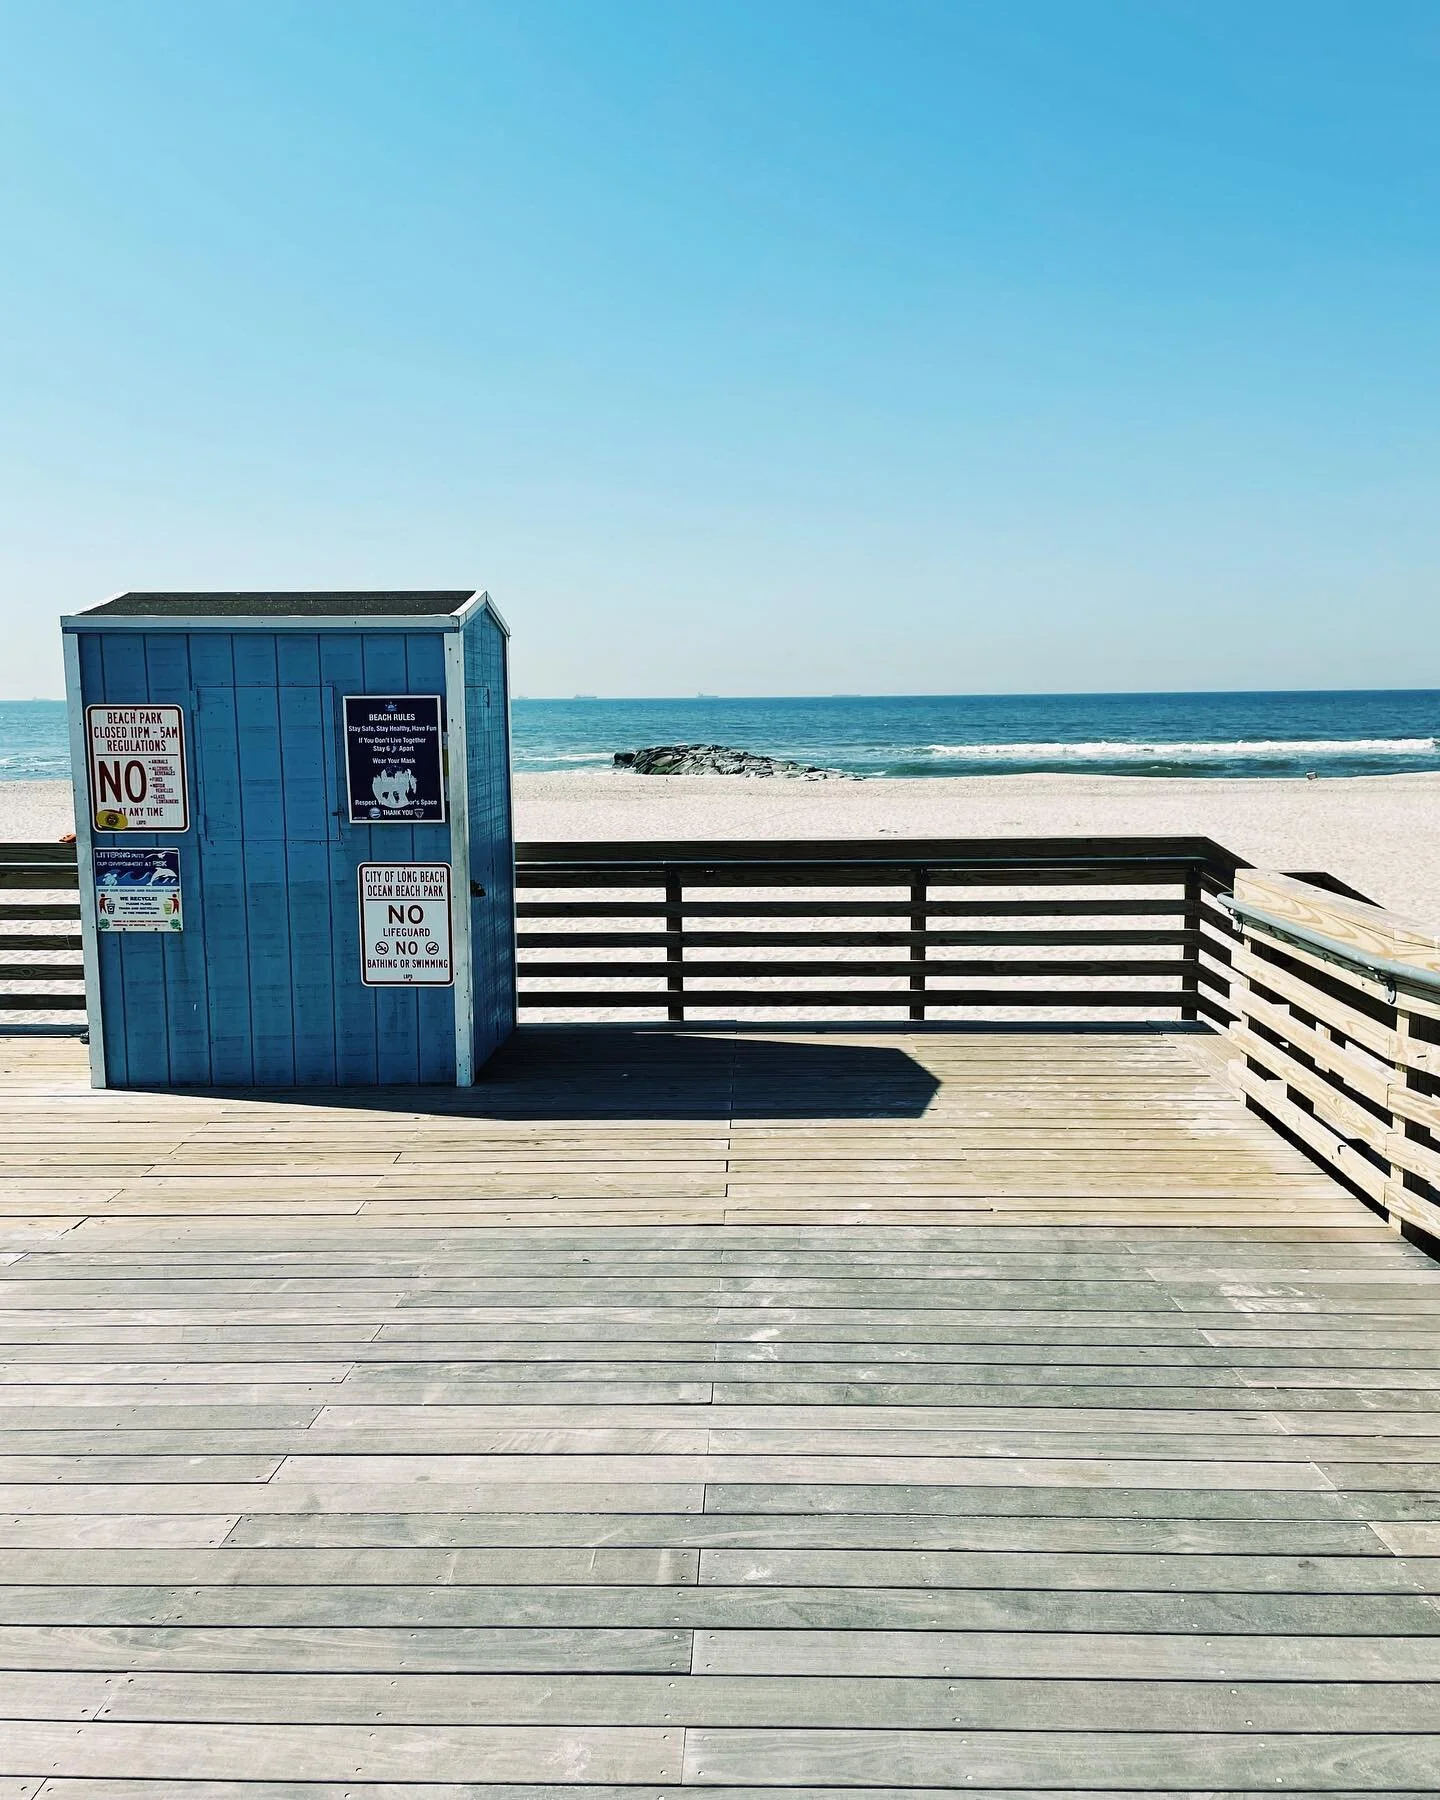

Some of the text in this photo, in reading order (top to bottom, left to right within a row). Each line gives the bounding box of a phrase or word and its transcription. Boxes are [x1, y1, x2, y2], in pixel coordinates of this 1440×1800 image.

[107, 712, 163, 724] BEACH PARK
[94, 726, 127, 738] CLOSED
[130, 726, 150, 738] 11PM
[160, 726, 178, 738] 5AM
[389, 725, 412, 733] Healthy,
[107, 740, 166, 751] REGULATIONS
[373, 745, 386, 753] Stay
[398, 745, 415, 753] Apart
[98, 760, 147, 803] NO
[129, 807, 144, 817] ANY
[147, 807, 164, 817] TIME
[365, 871, 445, 883] CITY OF LONG BEACH
[367, 885, 444, 897] OCEAN BEACH PARK
[388, 904, 424, 924] NO
[383, 928, 431, 937] LIFEGUARD
[395, 941, 418, 955] NO
[367, 959, 448, 968] BATHING OR SWIMMING
